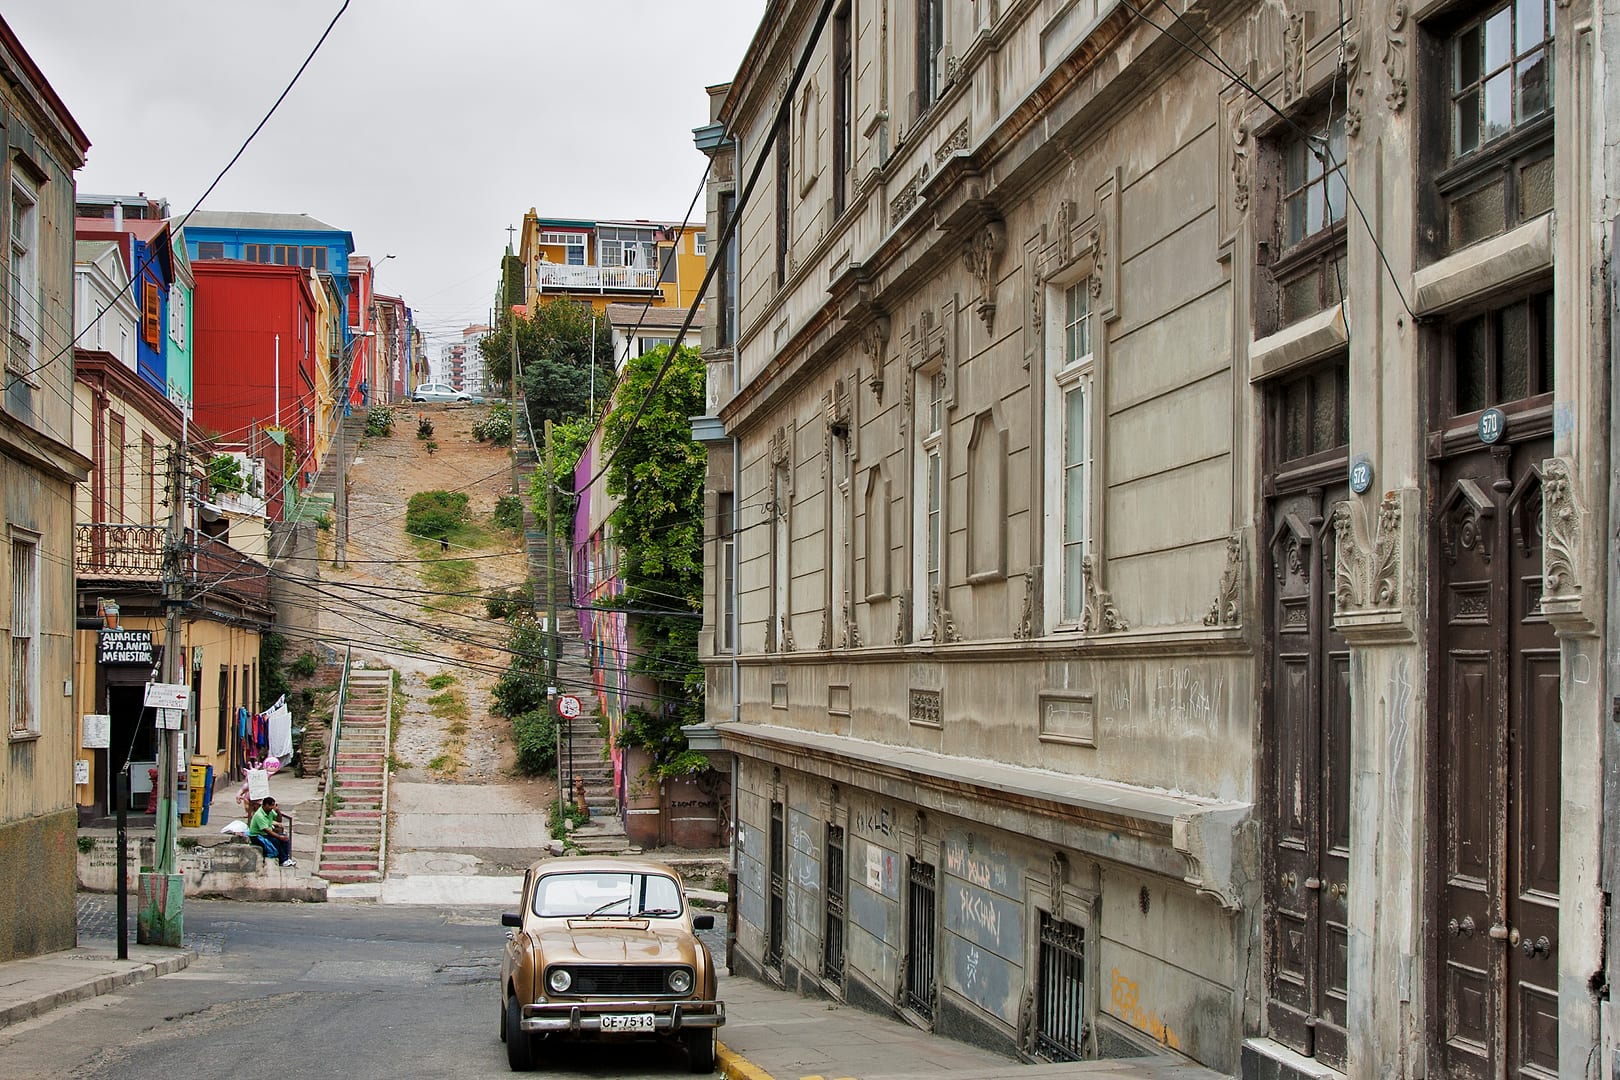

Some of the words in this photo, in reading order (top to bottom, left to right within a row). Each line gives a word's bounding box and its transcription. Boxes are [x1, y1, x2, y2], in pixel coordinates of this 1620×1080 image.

[1482, 413, 1497, 434] 570
[1353, 466, 1366, 484] 572
[102, 632, 151, 641] ALMACEN
